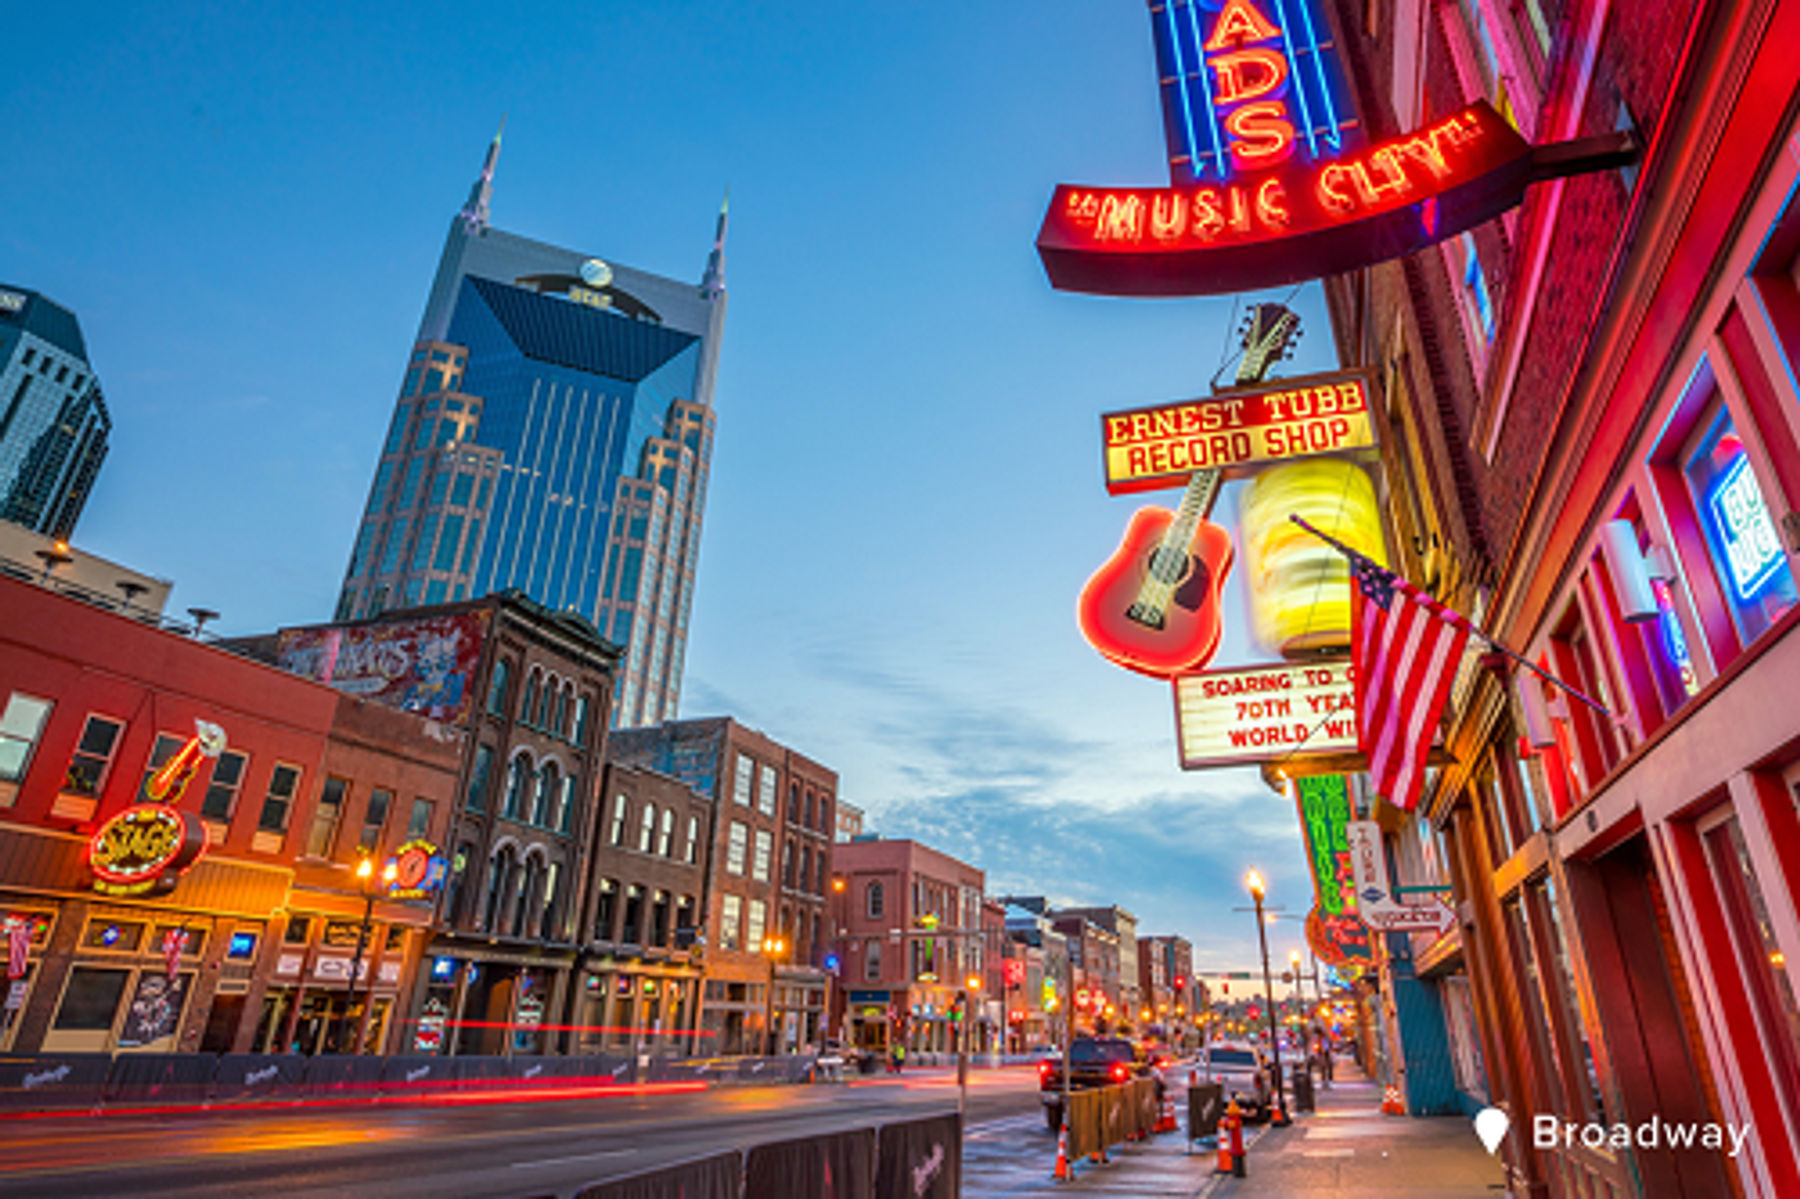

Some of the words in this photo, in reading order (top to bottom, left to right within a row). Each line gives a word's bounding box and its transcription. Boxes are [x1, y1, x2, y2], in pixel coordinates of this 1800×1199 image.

[1107, 400, 1244, 443] ERNEST
[1264, 381, 1362, 419] TUBB
[1127, 432, 1252, 475] RECORD
[1264, 418, 1350, 456] SHOP
[1202, 673, 1291, 699] SOARING
[1304, 669, 1332, 686] TO
[1235, 698, 1290, 721] 70TH
[1228, 724, 1308, 747] WORLD
